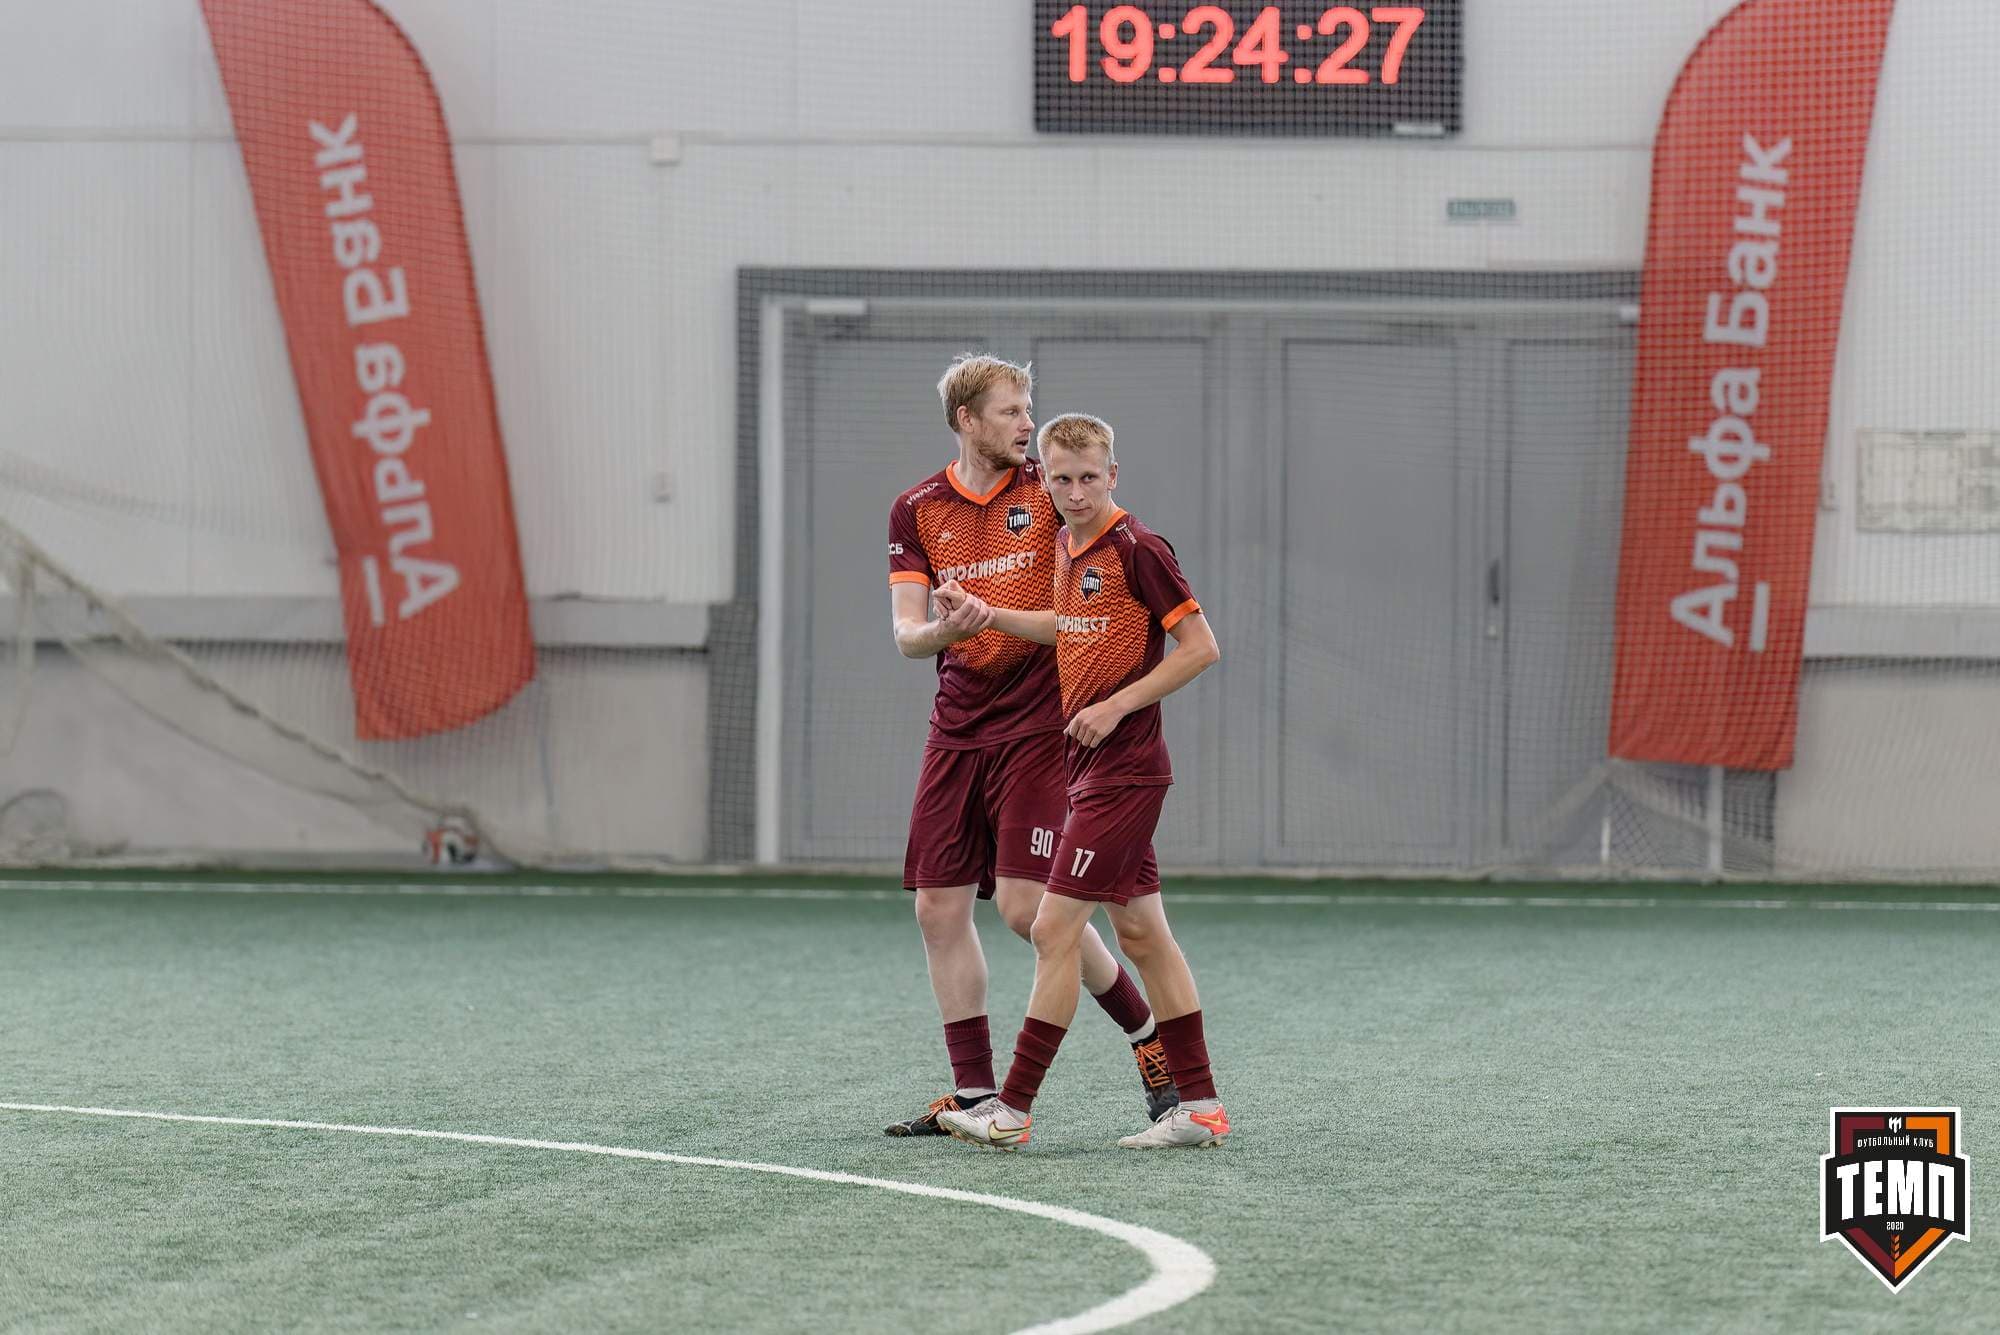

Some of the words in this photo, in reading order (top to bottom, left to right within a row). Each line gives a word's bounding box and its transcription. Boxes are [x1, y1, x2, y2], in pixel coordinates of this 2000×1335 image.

[1051, 5, 1426, 84] 19:24:27
[1705, 133, 1793, 346] Банк
[1008, 513, 1030, 529] ТЕМП
[1671, 368, 1771, 648] Альфа
[887, 542, 904, 555] СБ
[1055, 614, 1111, 633] ИНВЕСТ
[1030, 827, 1054, 858] 90
[1070, 847, 1096, 878] 17
